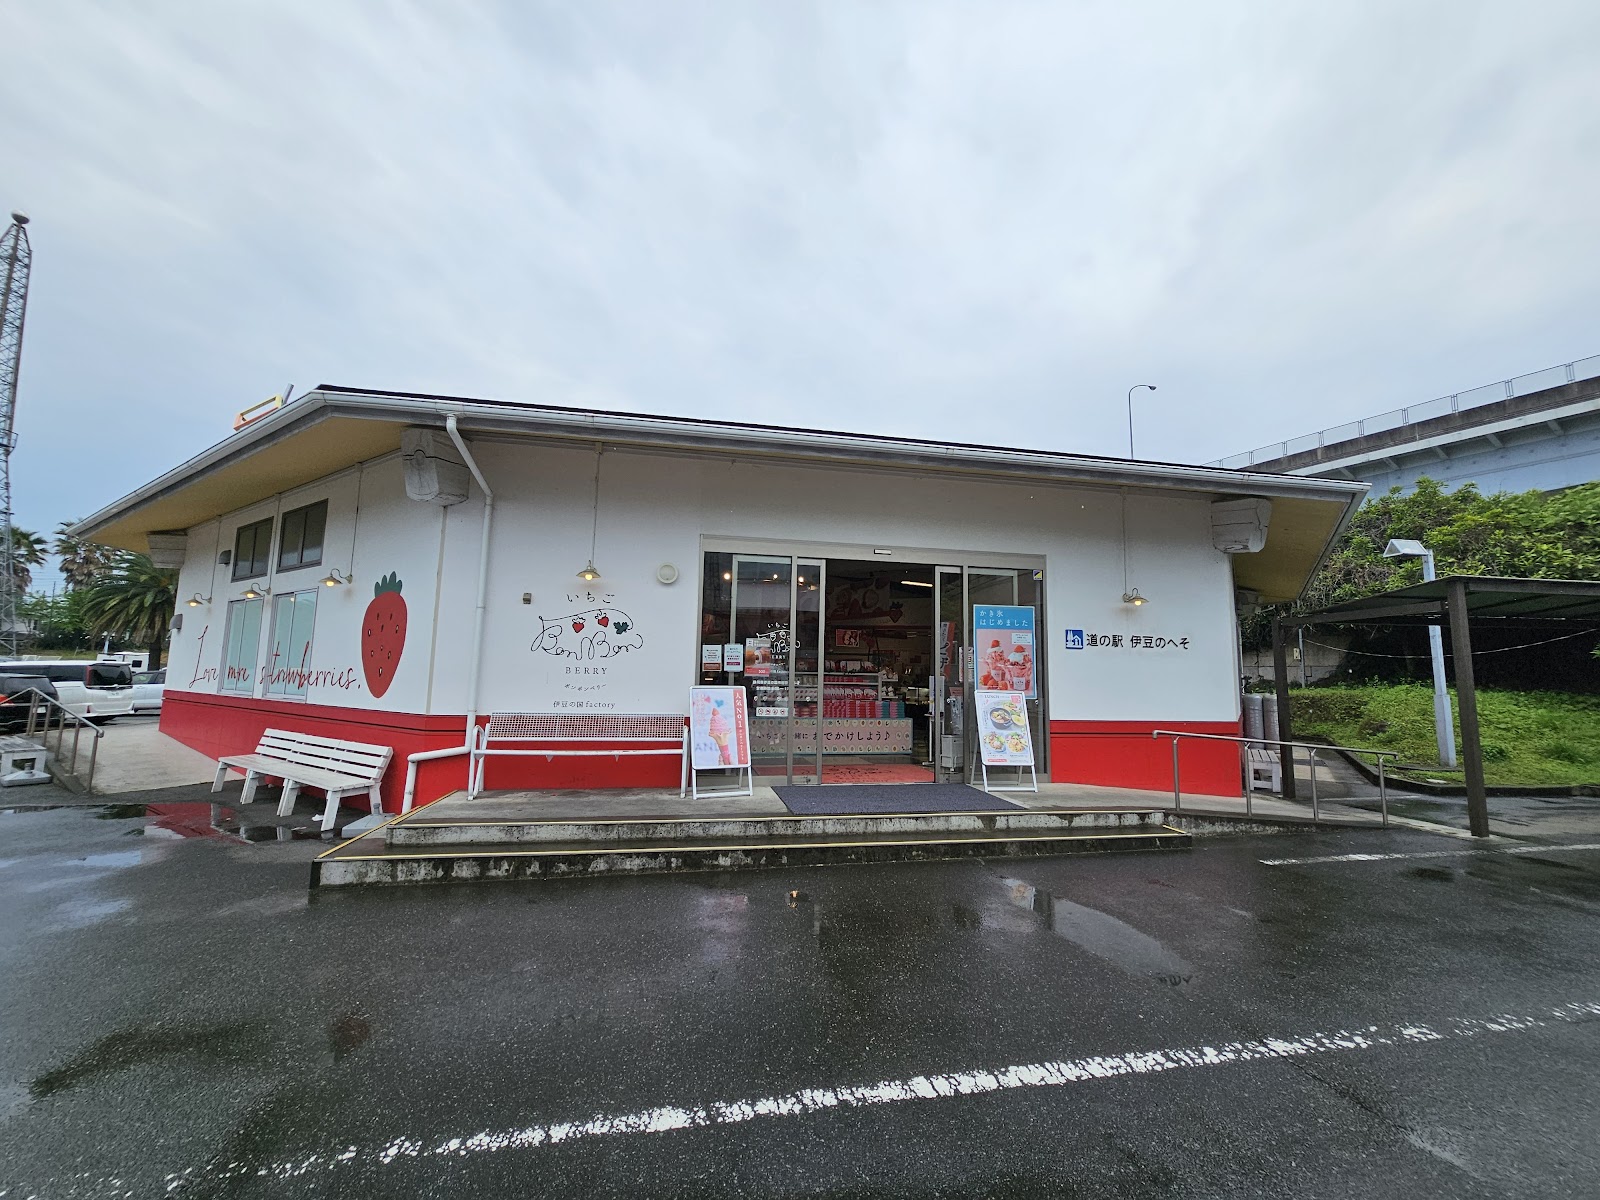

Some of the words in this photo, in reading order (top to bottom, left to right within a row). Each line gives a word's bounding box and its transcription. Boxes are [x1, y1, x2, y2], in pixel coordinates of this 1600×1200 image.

[566, 591, 616, 604] いちご
[979, 609, 1004, 618] かき氷
[979, 618, 1029, 627] はじめました
[1086, 633, 1123, 648] 道の駅
[1130, 635, 1190, 650] 伊豆のへそ
[189, 624, 219, 689] Love
[565, 666, 609, 675] BERRY
